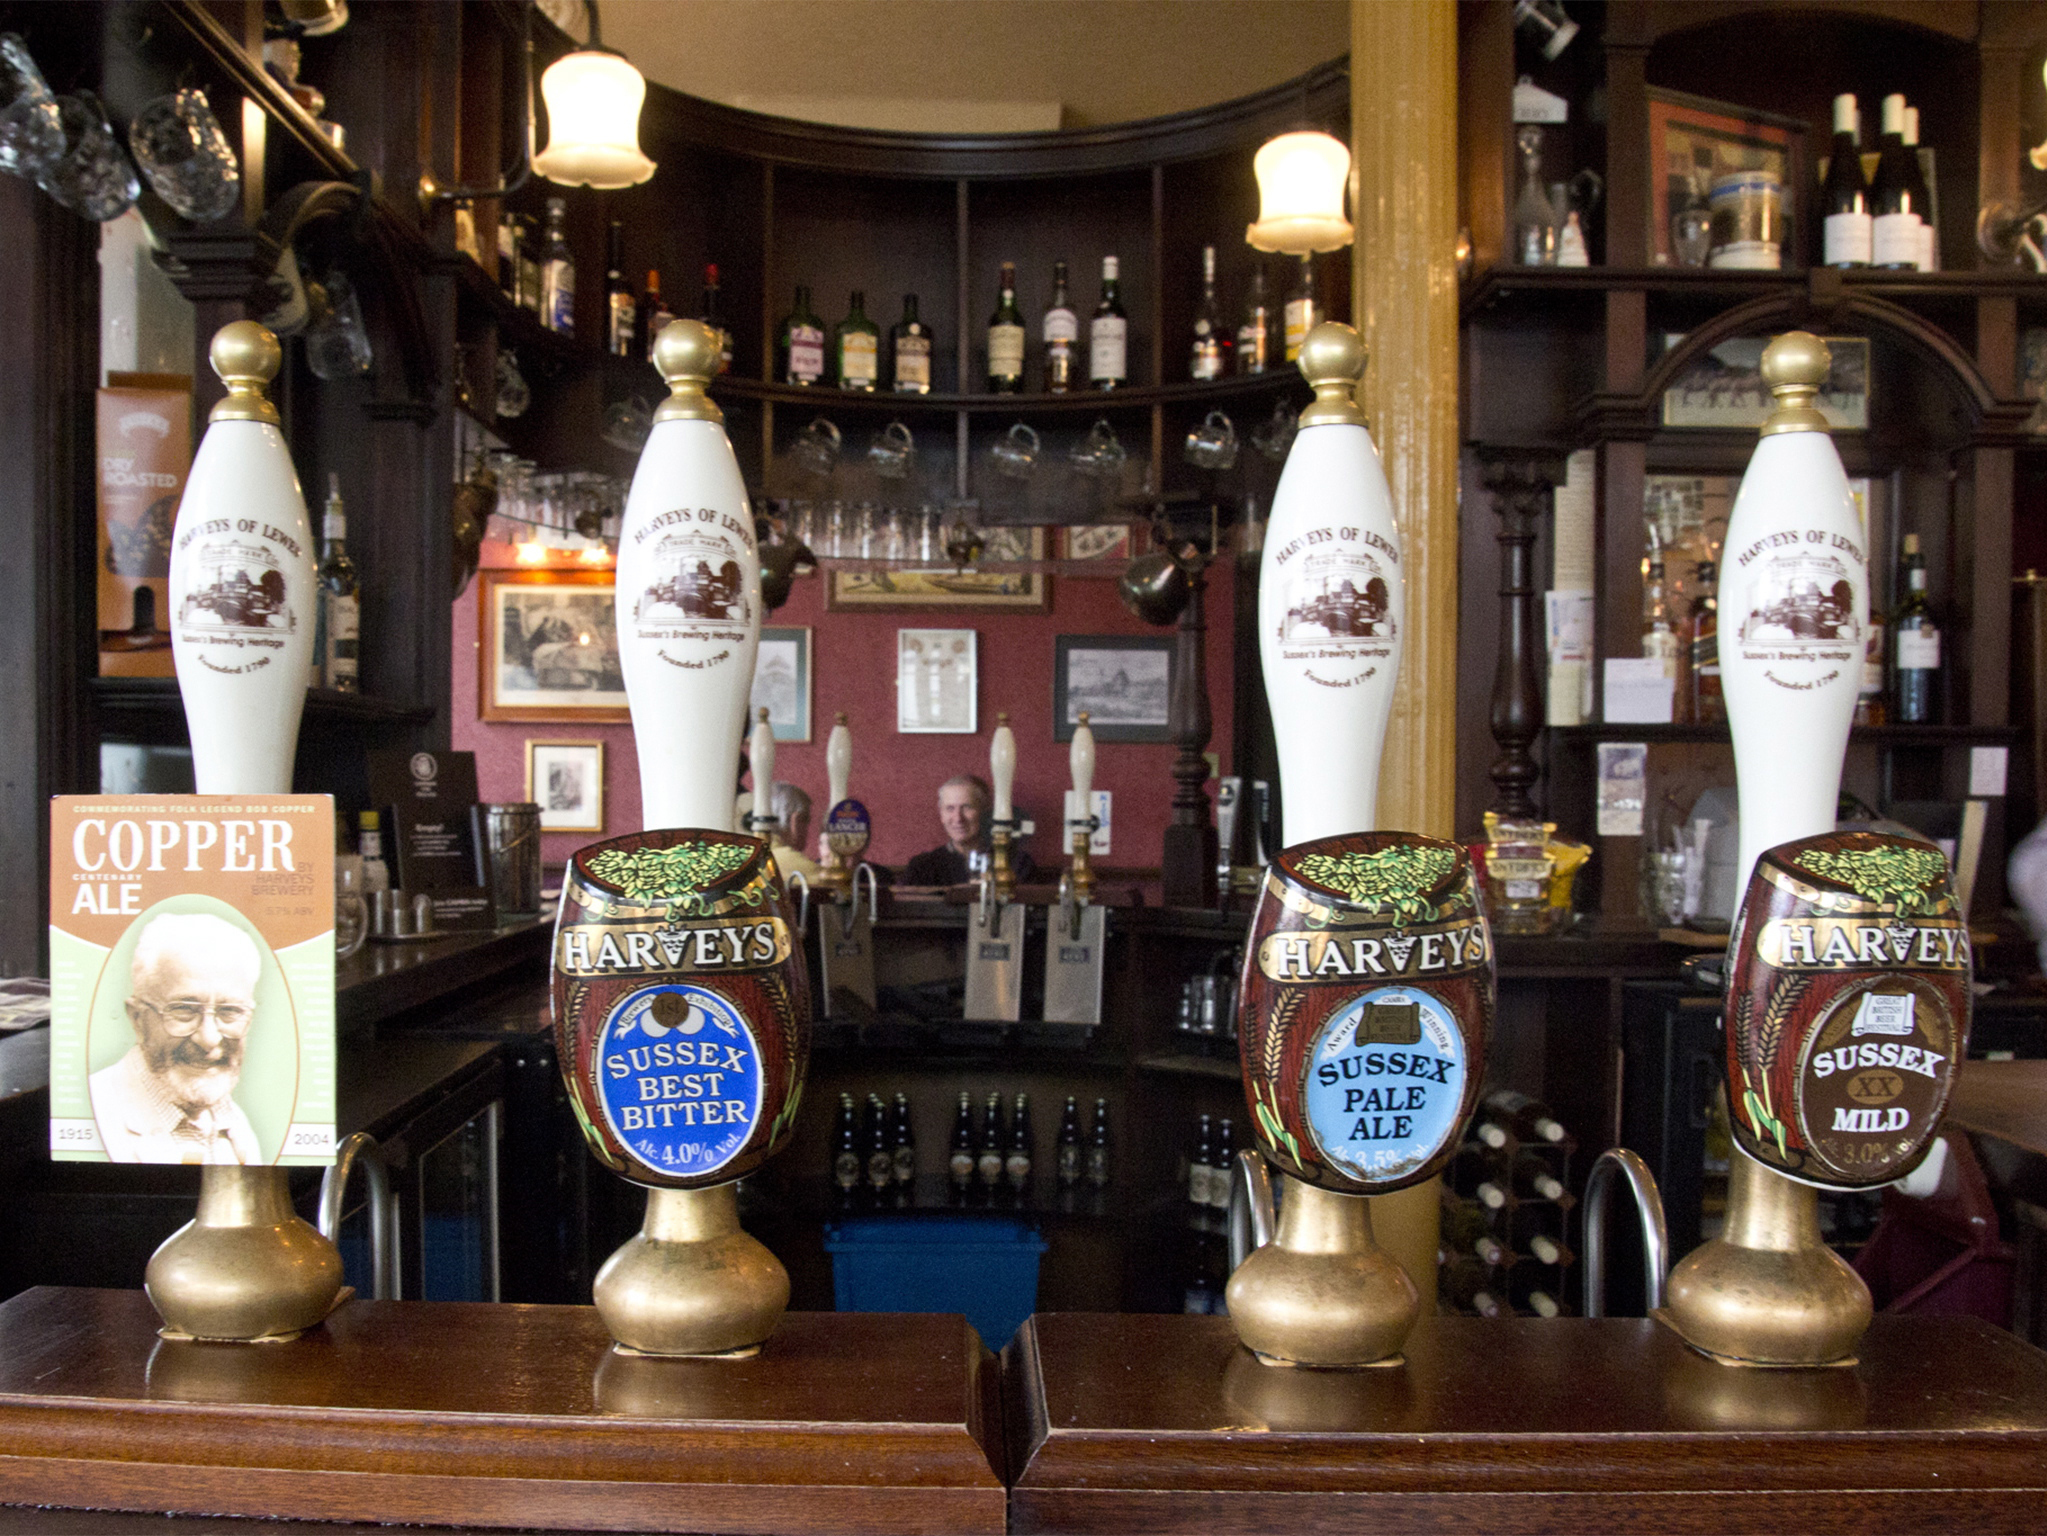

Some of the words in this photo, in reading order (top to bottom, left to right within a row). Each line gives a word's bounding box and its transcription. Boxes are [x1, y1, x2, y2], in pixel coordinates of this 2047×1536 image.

[103, 472, 178, 489] ROASTED
[698, 508, 718, 523] OF
[237, 518, 259, 534] OF
[1340, 526, 1360, 541] OF
[1806, 529, 1828, 544] OF
[210, 635, 245, 648] Brewing
[247, 636, 285, 649] Heritage
[672, 629, 710, 642] Brewing
[712, 630, 745, 643] Heritage
[1318, 649, 1356, 660] Brewing
[1358, 648, 1391, 659] Heritage
[1778, 650, 1816, 662] Brewing
[1819, 650, 1852, 662] Heritage
[72, 805, 167, 814] COMMEMORATING
[169, 805, 198, 814] FOLK
[200, 805, 243, 814] LEGEND
[245, 805, 269, 814] BOB
[271, 805, 316, 814] COPPER
[72, 818, 296, 872] COPPER
[297, 861, 314, 873] BY
[72, 873, 143, 881] CENTENARY
[255, 873, 315, 885] HARVEYS
[71, 883, 143, 915] ALE
[251, 885, 315, 896] BREWERY
[563, 922, 775, 972] HARVEYS
[1276, 922, 1486, 977] HARVEYS
[1327, 1016, 1358, 1051] Award
[1420, 1007, 1450, 1049] Winning
[606, 1042, 748, 1079] SUSSEX
[1813, 1043, 1946, 1078] SUSSEX
[1317, 1053, 1456, 1087] SUSSEX
[637, 1072, 726, 1101] BEST
[1343, 1086, 1427, 1113] PALE
[621, 1100, 750, 1131] BITTER
[1831, 1107, 1911, 1133] MILD
[58, 1128, 94, 1141] 1915
[1348, 1115, 1414, 1141] ALE
[293, 1133, 330, 1146] 2004
[661, 1142, 714, 1165] 4.0%
[715, 1133, 742, 1154] Vol.
[1355, 1149, 1403, 1170] 3.5%
